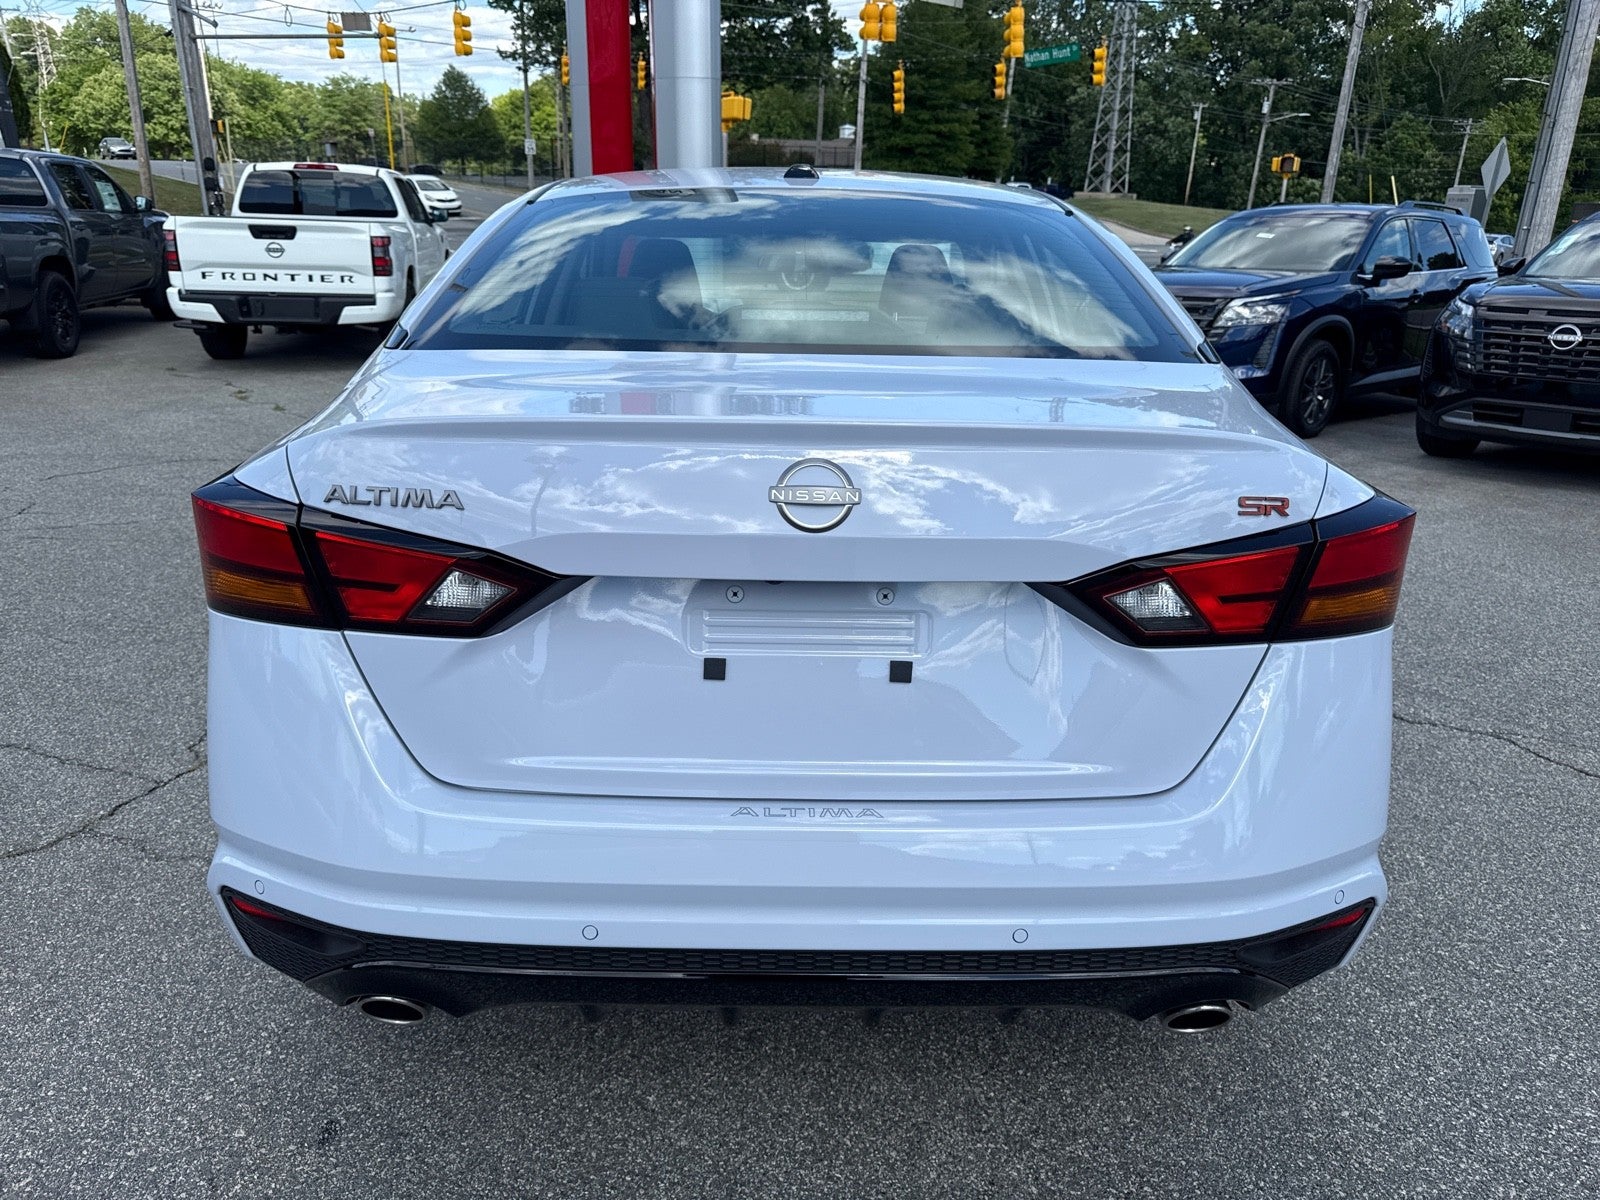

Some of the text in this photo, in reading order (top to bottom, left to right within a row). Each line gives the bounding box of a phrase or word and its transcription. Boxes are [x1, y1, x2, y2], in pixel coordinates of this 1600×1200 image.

[1024, 51, 1050, 63] Nathan
[1052, 46, 1071, 59] Hunt
[200, 270, 356, 285] FRONTIER
[1547, 334, 1583, 342] NISSAN
[323, 484, 465, 511] ALTIMA
[771, 489, 859, 502] NISSAN
[1238, 496, 1290, 517] SR
[730, 806, 884, 818] ALTIMA
